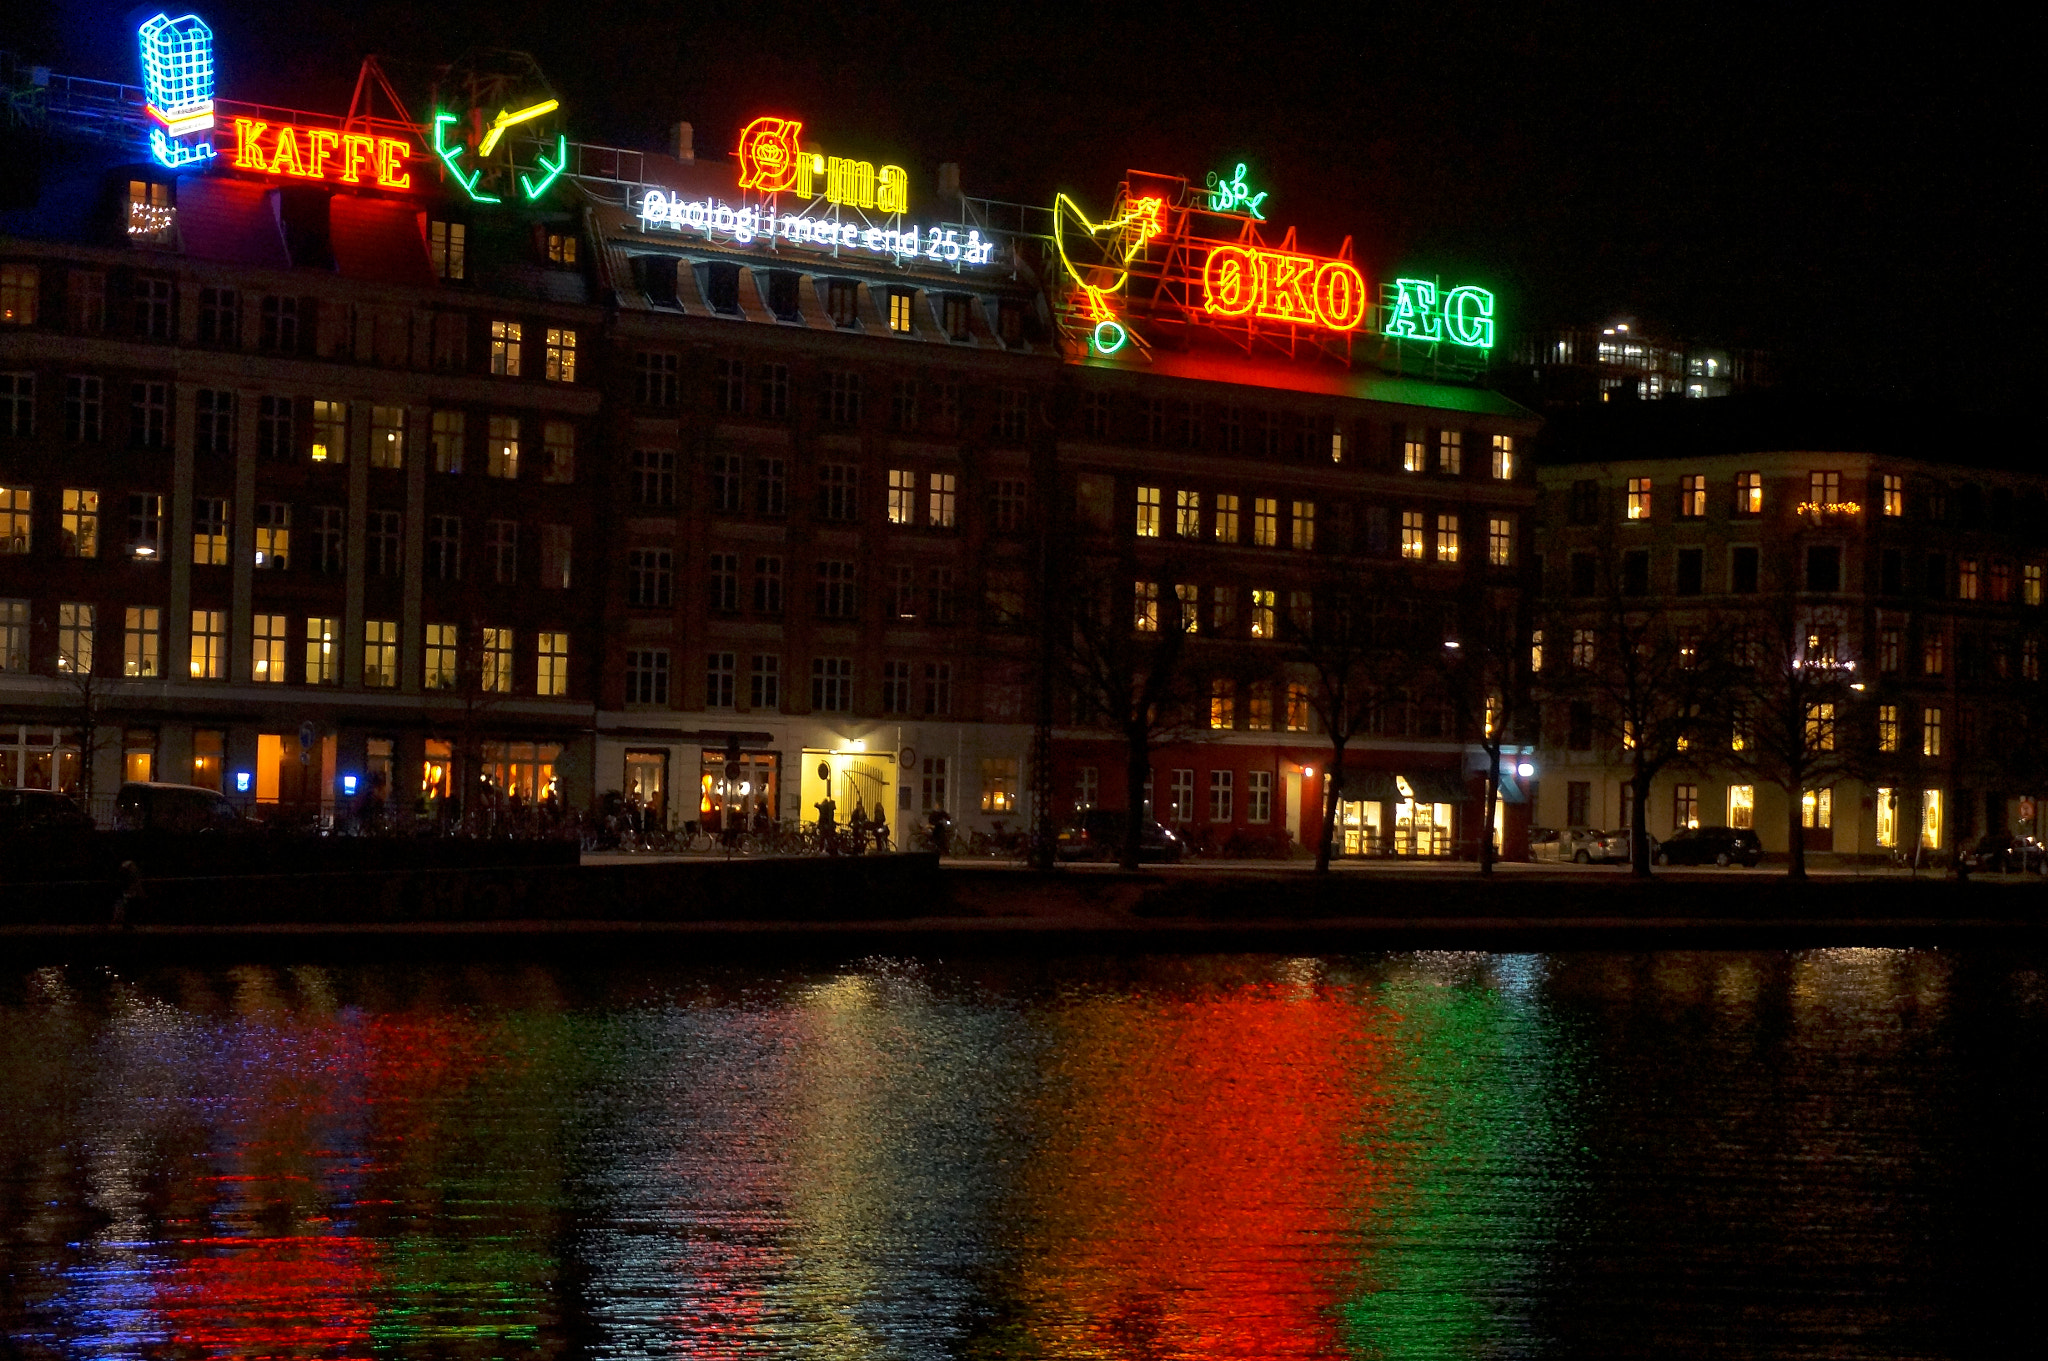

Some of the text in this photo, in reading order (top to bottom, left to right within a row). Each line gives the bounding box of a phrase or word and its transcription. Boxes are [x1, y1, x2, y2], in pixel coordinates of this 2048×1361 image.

[234, 119, 410, 188] KAFFE
[643, 190, 757, 243] Økologi
[784, 213, 857, 249] mere
[867, 225, 918, 256] end
[927, 227, 961, 261] 25
[1204, 246, 1365, 330] ØKO
